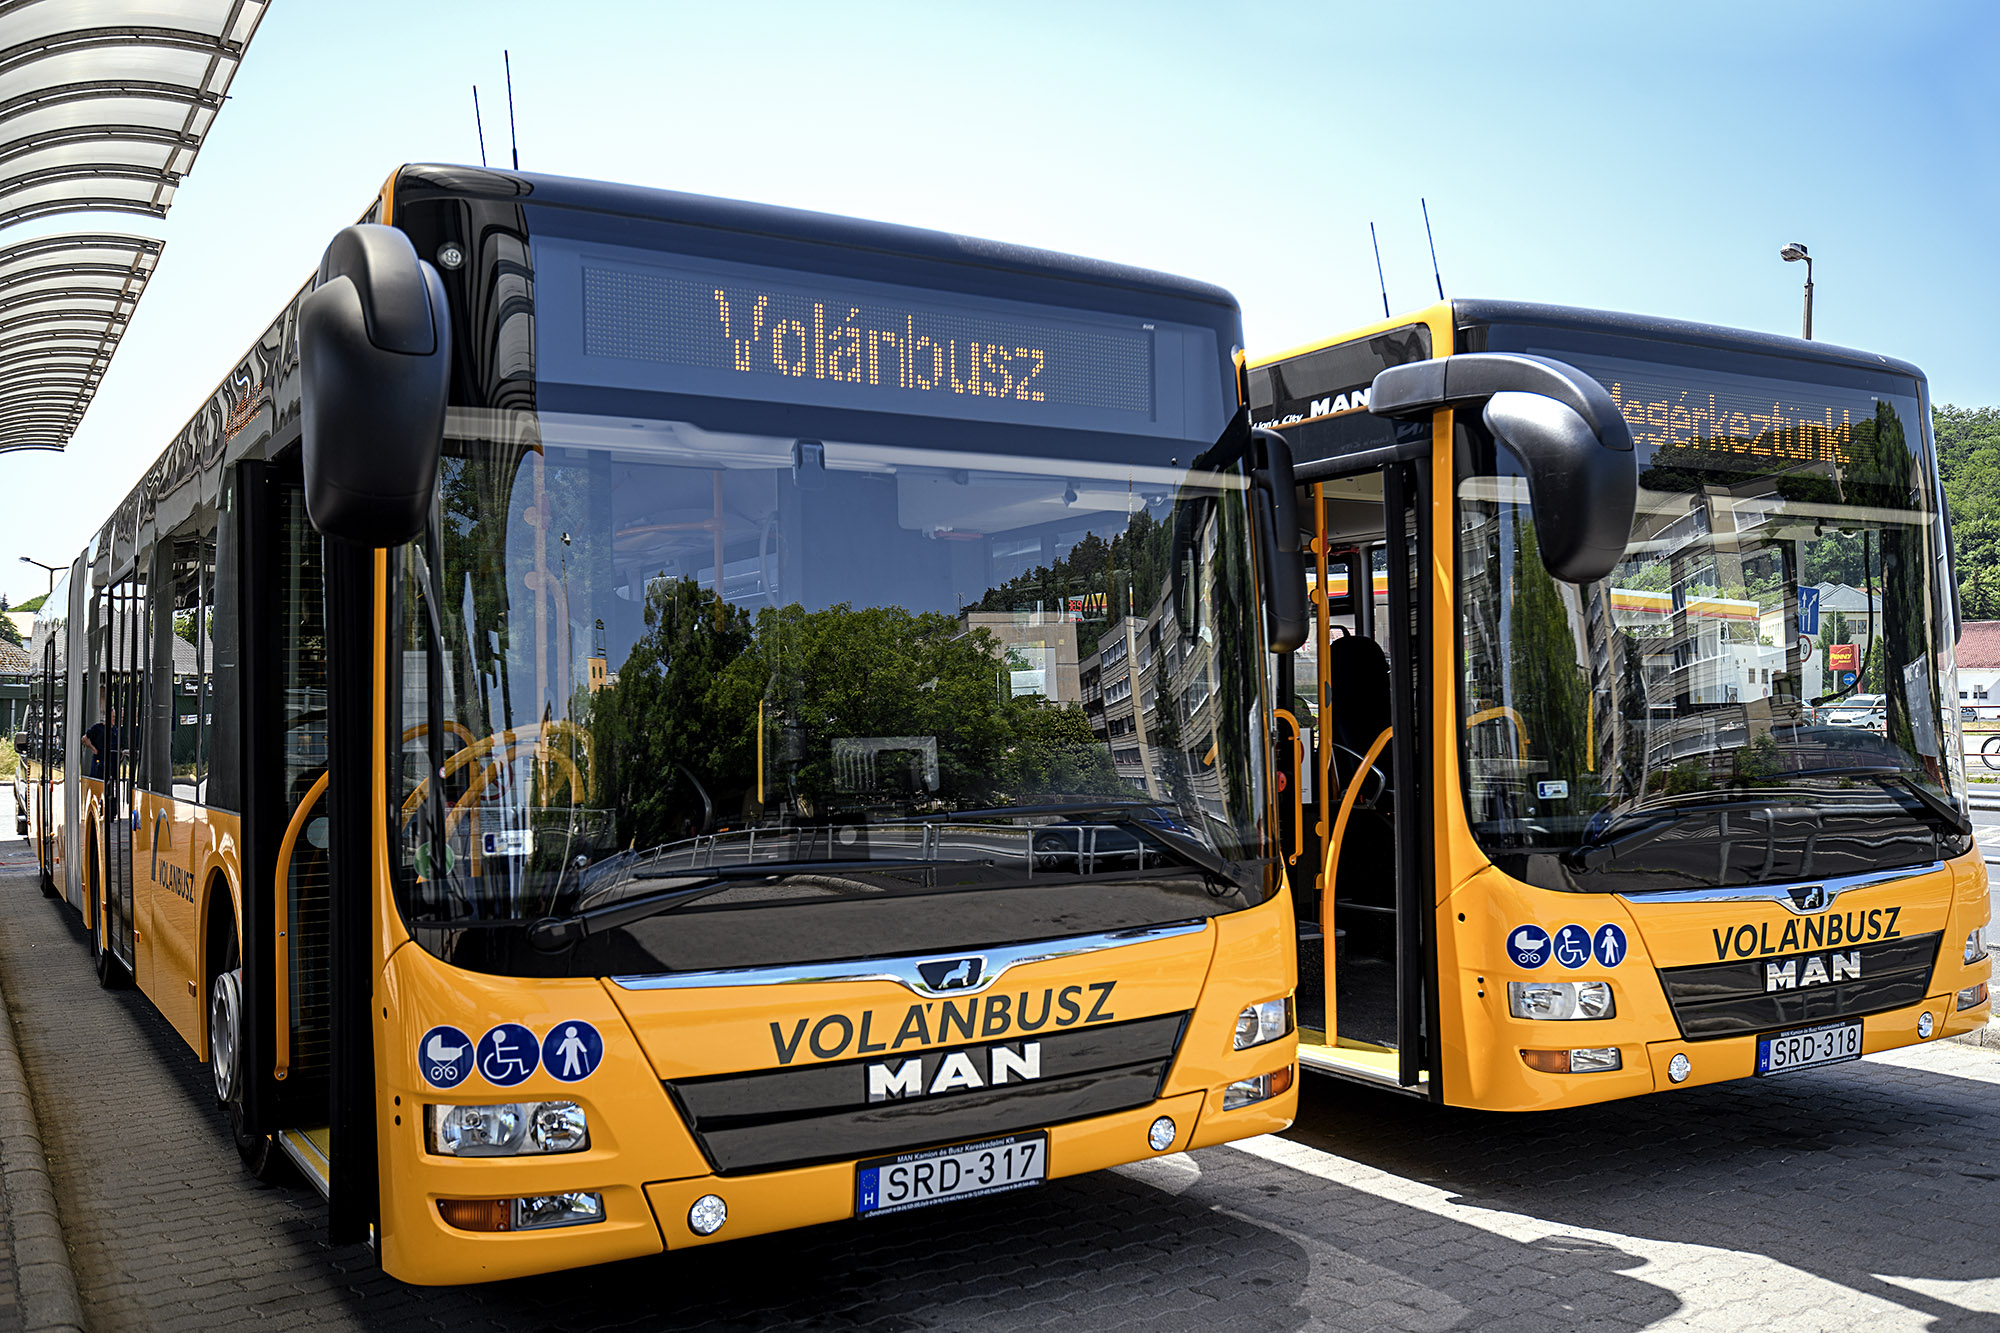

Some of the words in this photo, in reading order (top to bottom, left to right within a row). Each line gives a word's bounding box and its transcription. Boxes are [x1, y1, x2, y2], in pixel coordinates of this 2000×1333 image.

[714, 289, 1045, 402] Volánbusz
[1282, 413, 1304, 424] City
[1310, 388, 1371, 418] MAN
[1712, 906, 1902, 960] VOLÁNBUSZ
[1766, 951, 1861, 992] MAN
[769, 980, 1118, 1065] VOLÁNBUSZ
[1761, 1058, 1768, 1068] H
[1774, 1027, 1857, 1067] SRD-318
[866, 1041, 1041, 1104] MAN
[887, 1143, 1037, 1202] SRD-317
[896, 1154, 914, 1164] MAN
[913, 1149, 938, 1161] Kamion
[864, 1192, 874, 1206] H
